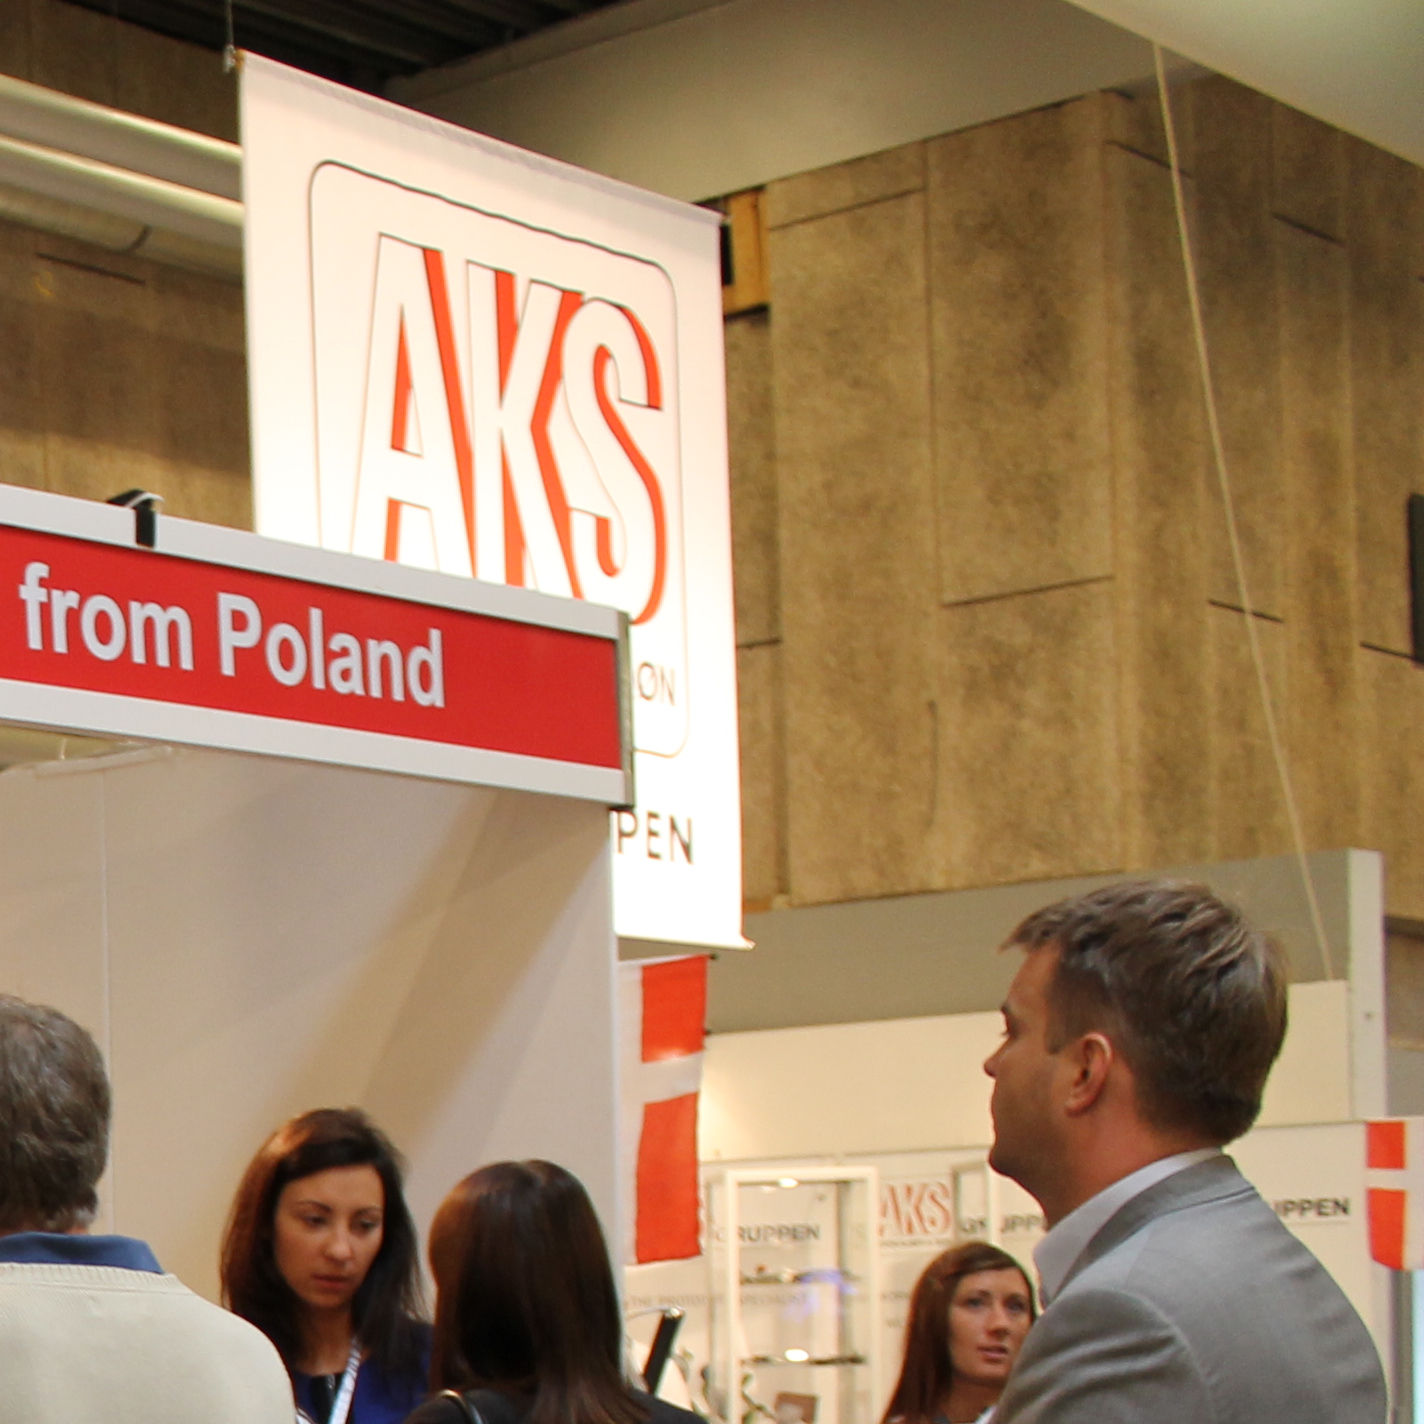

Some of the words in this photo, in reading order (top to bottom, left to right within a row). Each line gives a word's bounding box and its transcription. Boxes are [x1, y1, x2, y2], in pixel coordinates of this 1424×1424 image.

[350, 232, 666, 626] AKS
[19, 561, 194, 671] from
[217, 592, 446, 708] Poland
[616, 810, 694, 866] PEN
[879, 1181, 951, 1236] AKS
